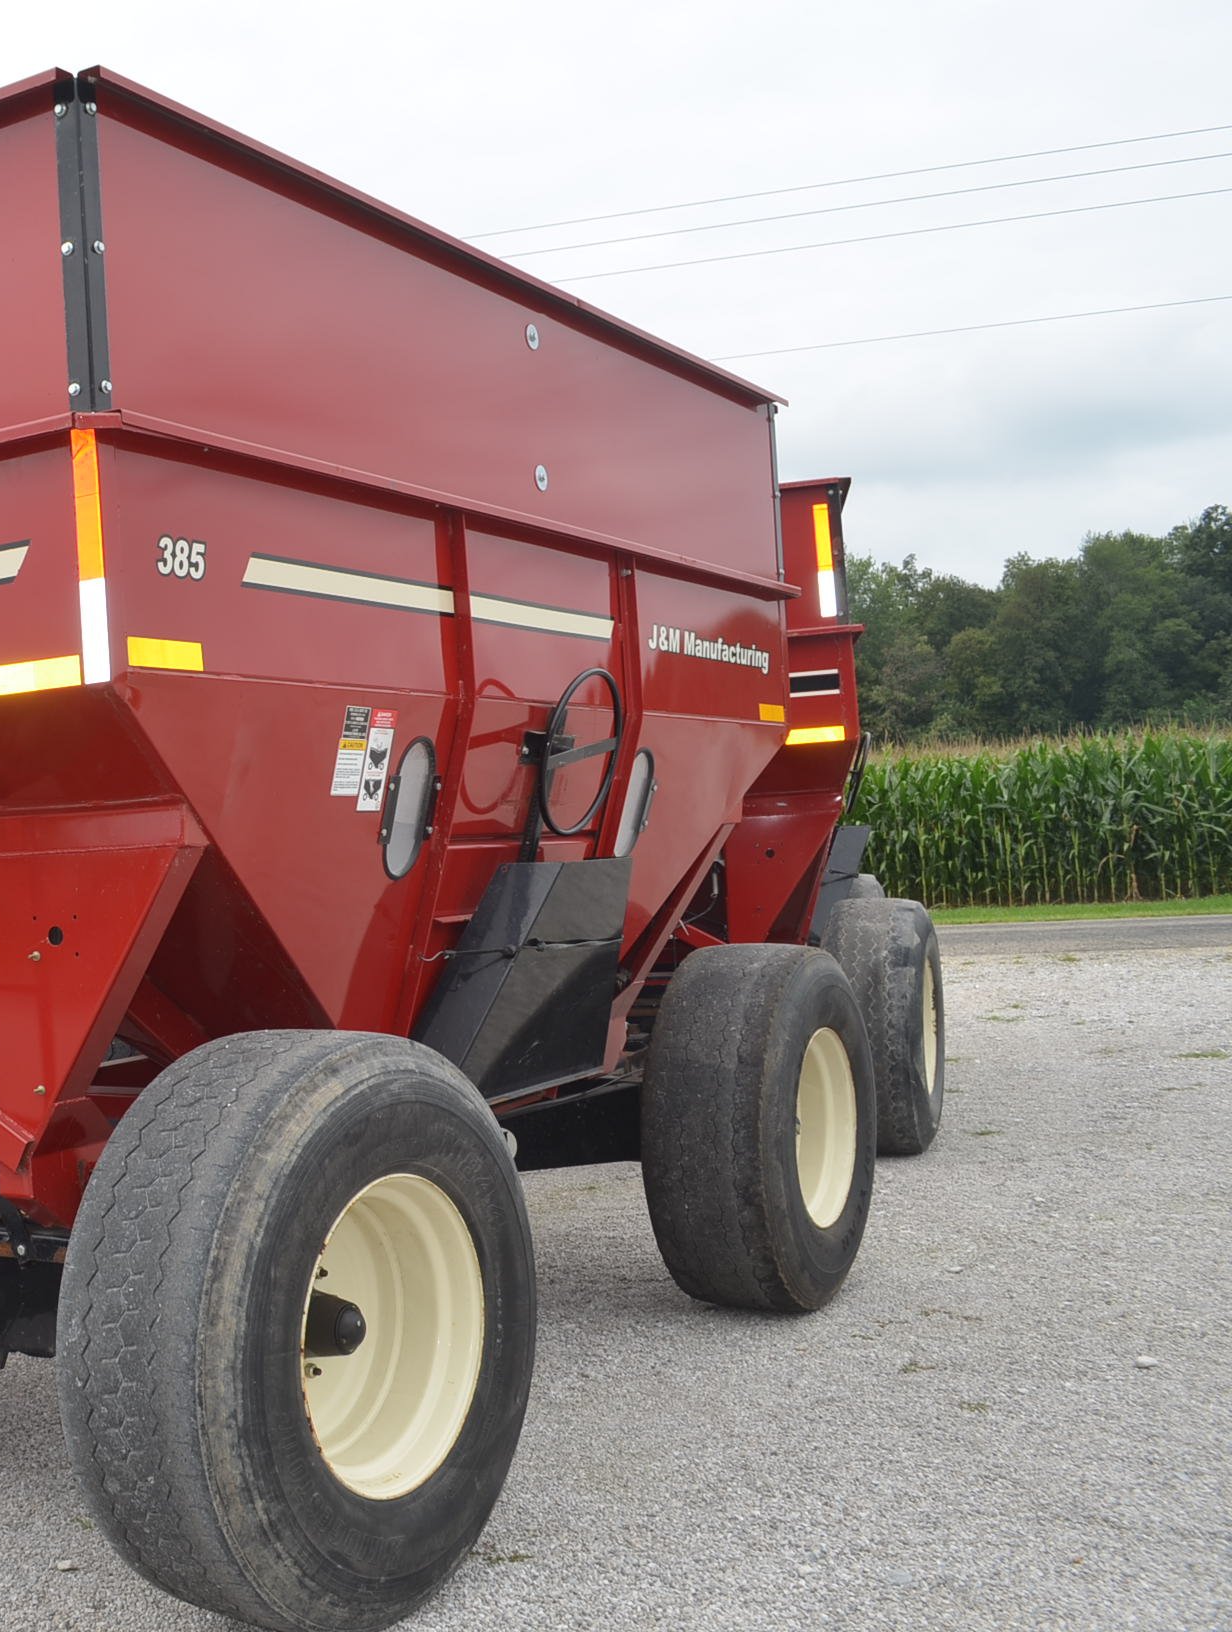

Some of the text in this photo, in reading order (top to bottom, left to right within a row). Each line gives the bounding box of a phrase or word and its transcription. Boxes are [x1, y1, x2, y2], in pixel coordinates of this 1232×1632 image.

[156, 535, 206, 580] 385
[647, 623, 770, 675] J&M Manufacturing
